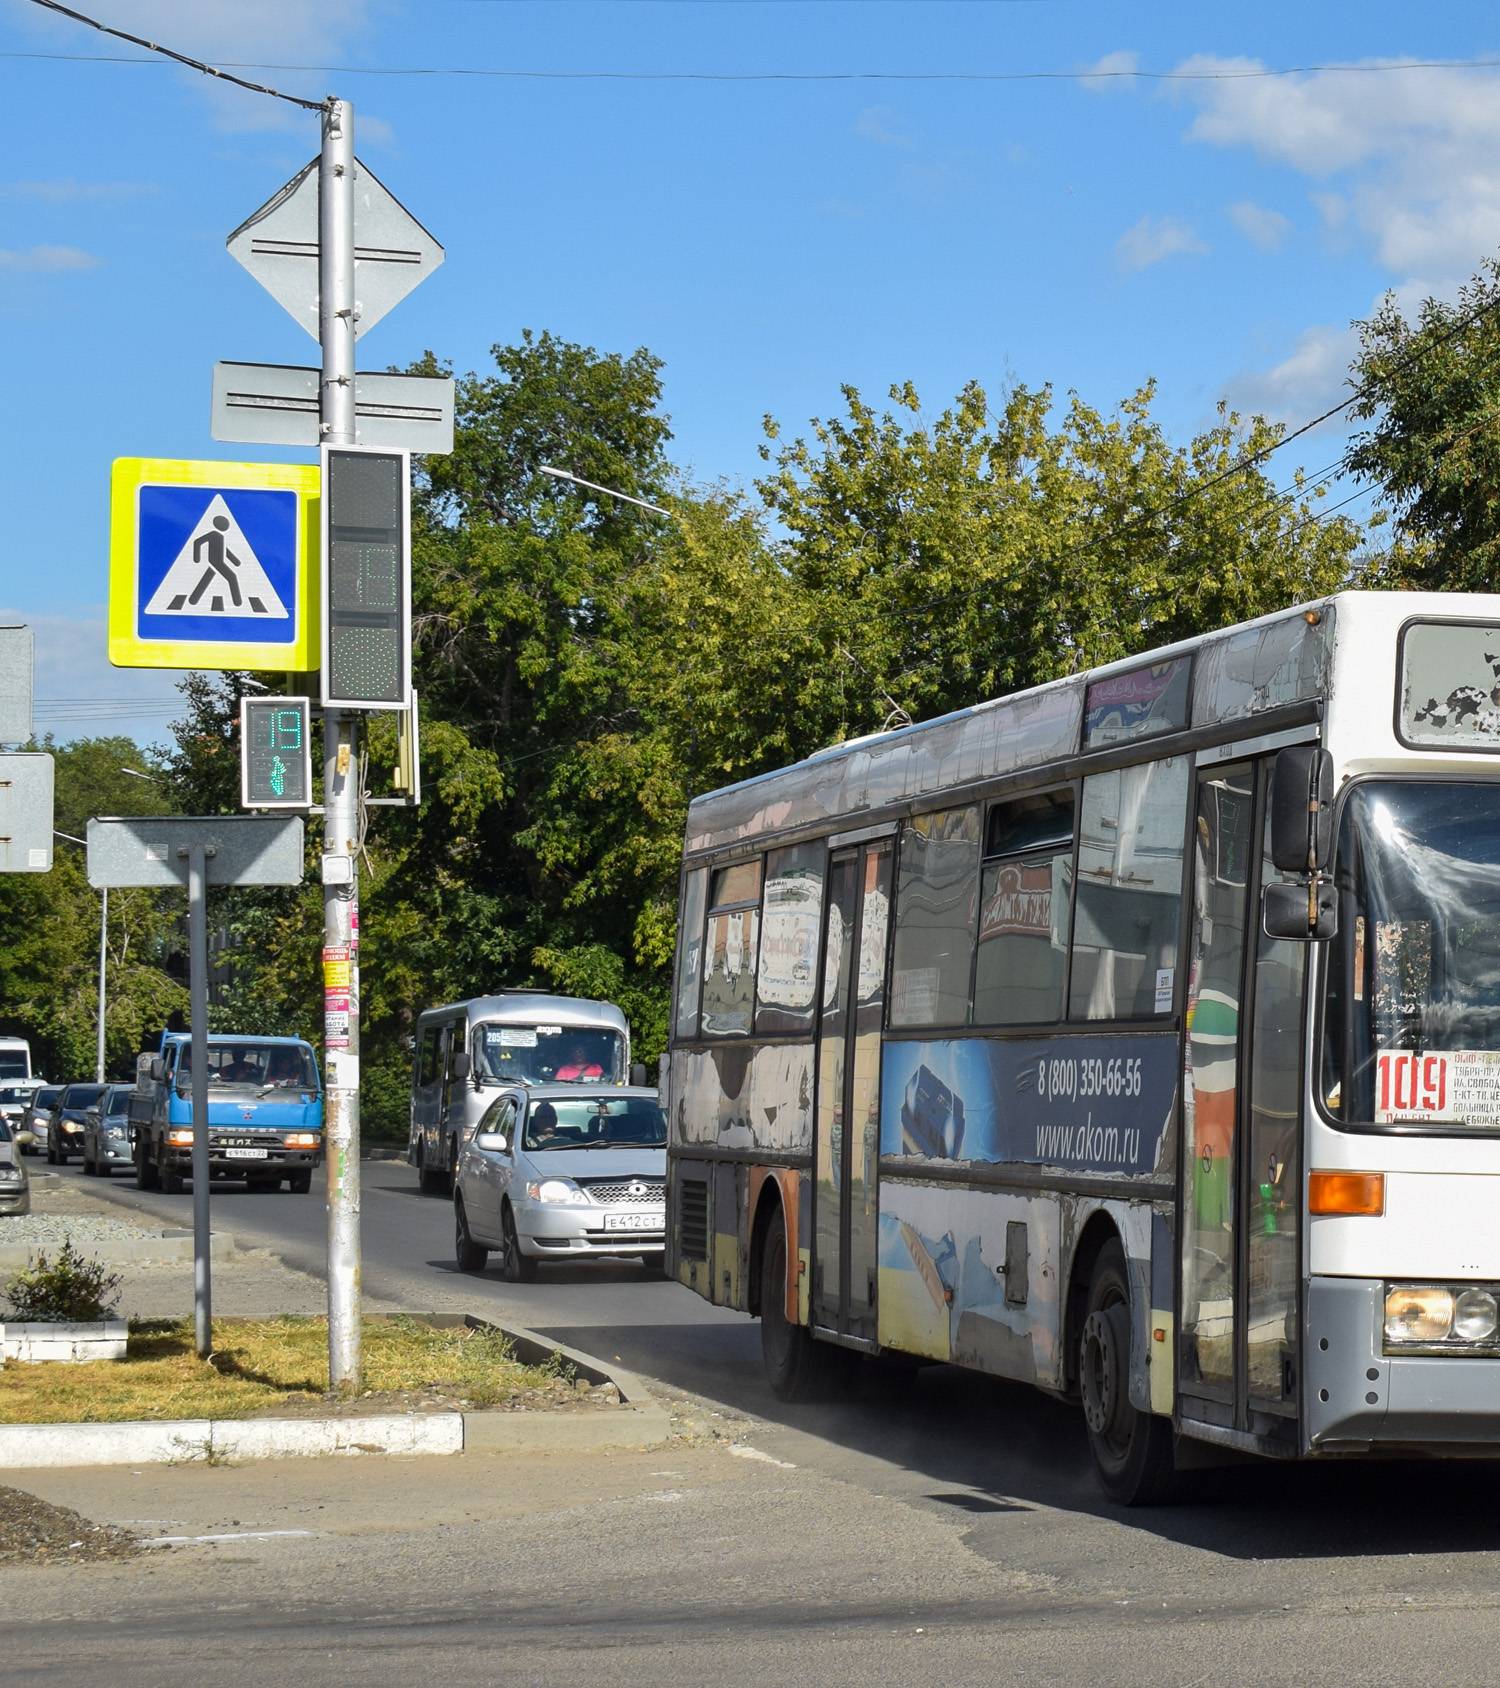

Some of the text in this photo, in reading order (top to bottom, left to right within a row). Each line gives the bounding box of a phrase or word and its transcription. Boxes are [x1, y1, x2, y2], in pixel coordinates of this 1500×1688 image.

[271, 711, 301, 749] 19
[487, 1032, 501, 1043] 205
[1038, 1058, 1142, 1103] 8 (800) 350-66-56
[1378, 1055, 1447, 1111] 109
[1036, 1112, 1140, 1164] www.akom.ru
